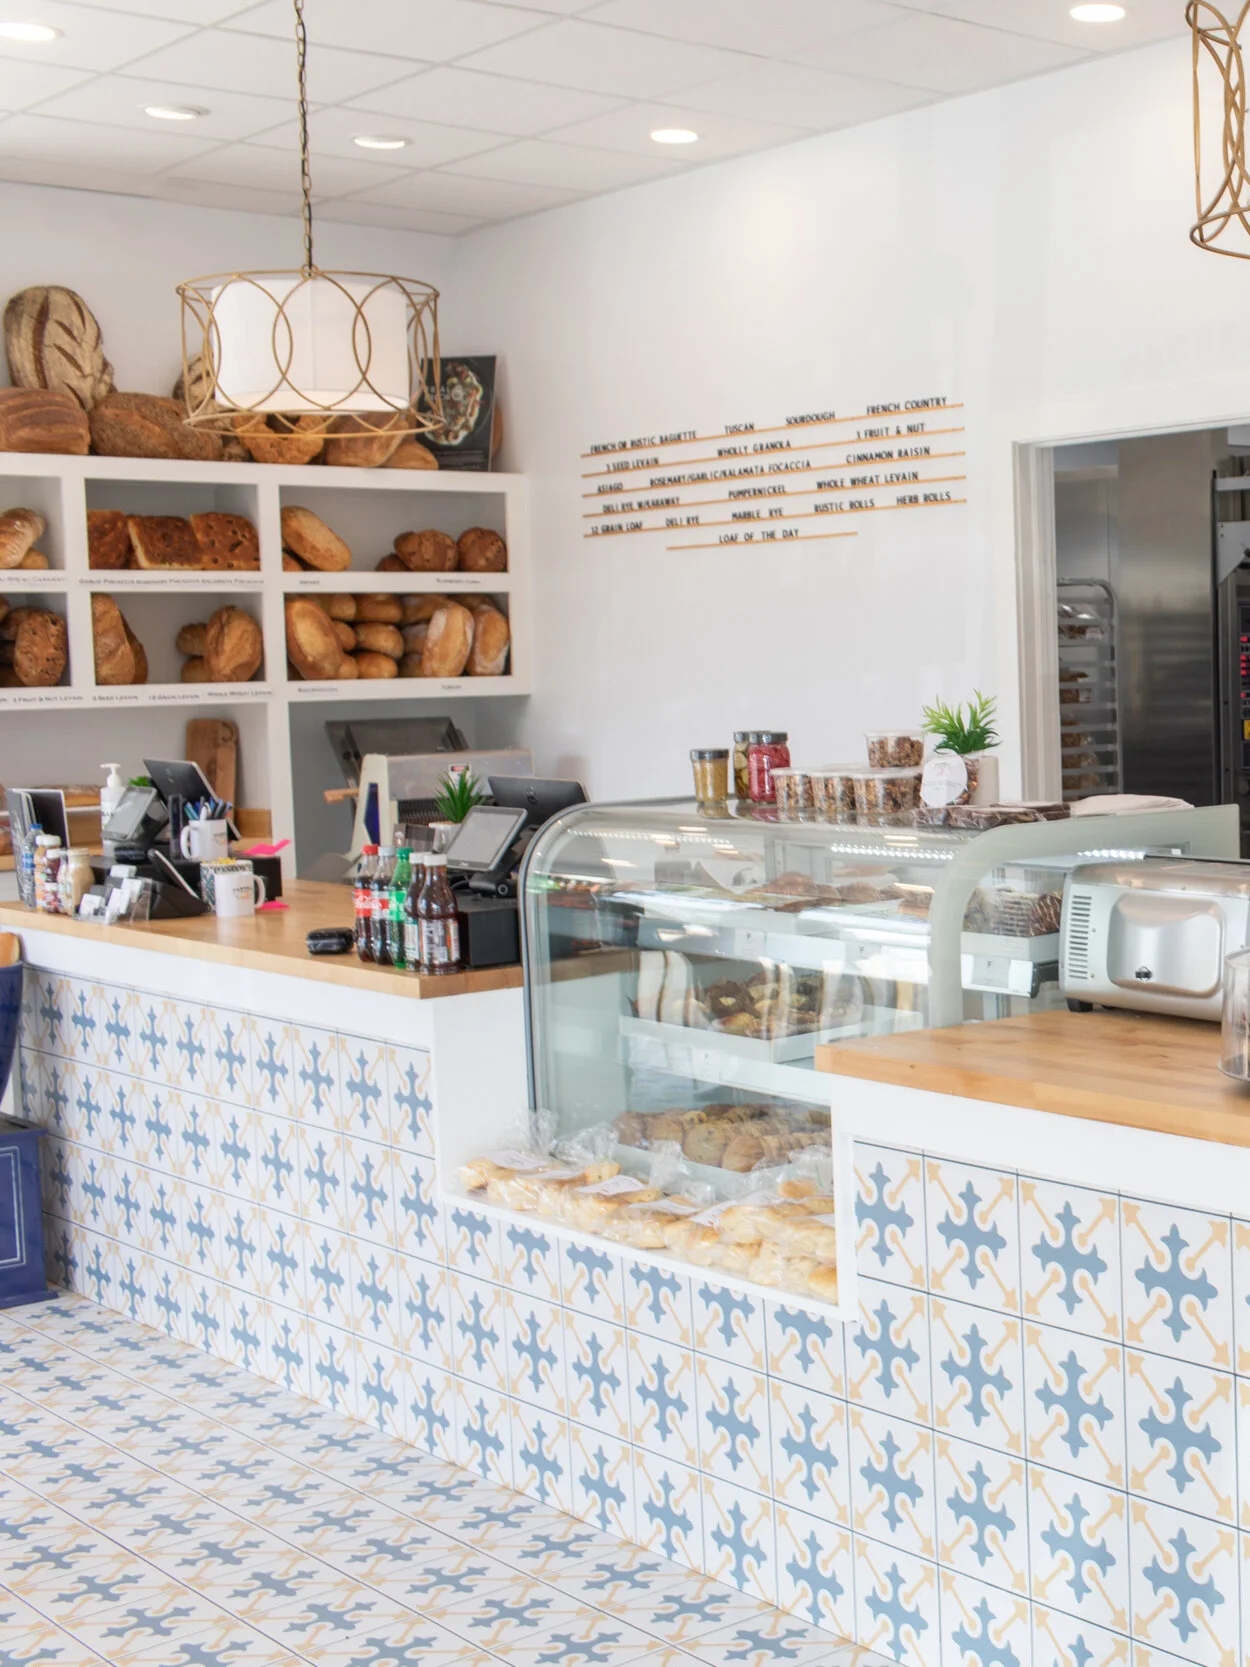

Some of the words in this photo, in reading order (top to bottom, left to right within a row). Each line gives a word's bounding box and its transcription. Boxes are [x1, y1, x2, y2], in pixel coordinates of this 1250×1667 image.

[866, 403, 900, 414] FRENCH
[905, 396, 947, 410] COUNTRY
[786, 411, 836, 425] SOURDOUGH
[725, 423, 755, 434] TUSCAN
[865, 427, 889, 438] FRUIT
[896, 426, 902, 434] &
[907, 423, 925, 433] NUT
[590, 441, 616, 454] FRENCH
[631, 436, 656, 447] RUSTIC
[660, 430, 696, 444] BAGUETTE
[717, 446, 748, 457] WHOLLY
[753, 440, 790, 452] GRANOLA
[846, 449, 893, 464] CINNAMON
[898, 446, 930, 458] RAISIN
[612, 461, 629, 470] SEED
[632, 458, 659, 469] LEVAIN
[650, 466, 764, 488] ROSEMARY/GARLIC/KALAMATA
[768, 460, 811, 473] FOCACCIA
[816, 479, 844, 489] WHOLE
[850, 475, 879, 486] WHEAT
[884, 472, 918, 482] LEVAIN
[597, 482, 623, 493] ASIAGO
[728, 484, 786, 498] PUMPERNICKEL
[896, 495, 918, 505] HERB
[923, 492, 950, 502] ROLLS
[603, 504, 618, 513] DELI
[621, 502, 633, 510] RYE
[814, 501, 843, 512] RUSTIC
[849, 500, 874, 509] ROLLS
[732, 510, 760, 520] MARBLE
[768, 508, 783, 516] RYE
[601, 523, 622, 533] GRAIN
[626, 522, 642, 530] LOAF
[666, 518, 682, 527] DELI
[686, 516, 700, 524] RYE
[719, 534, 738, 543] LOAF
[744, 533, 753, 541] OF
[762, 531, 776, 540] THE
[782, 528, 799, 538] DAY
